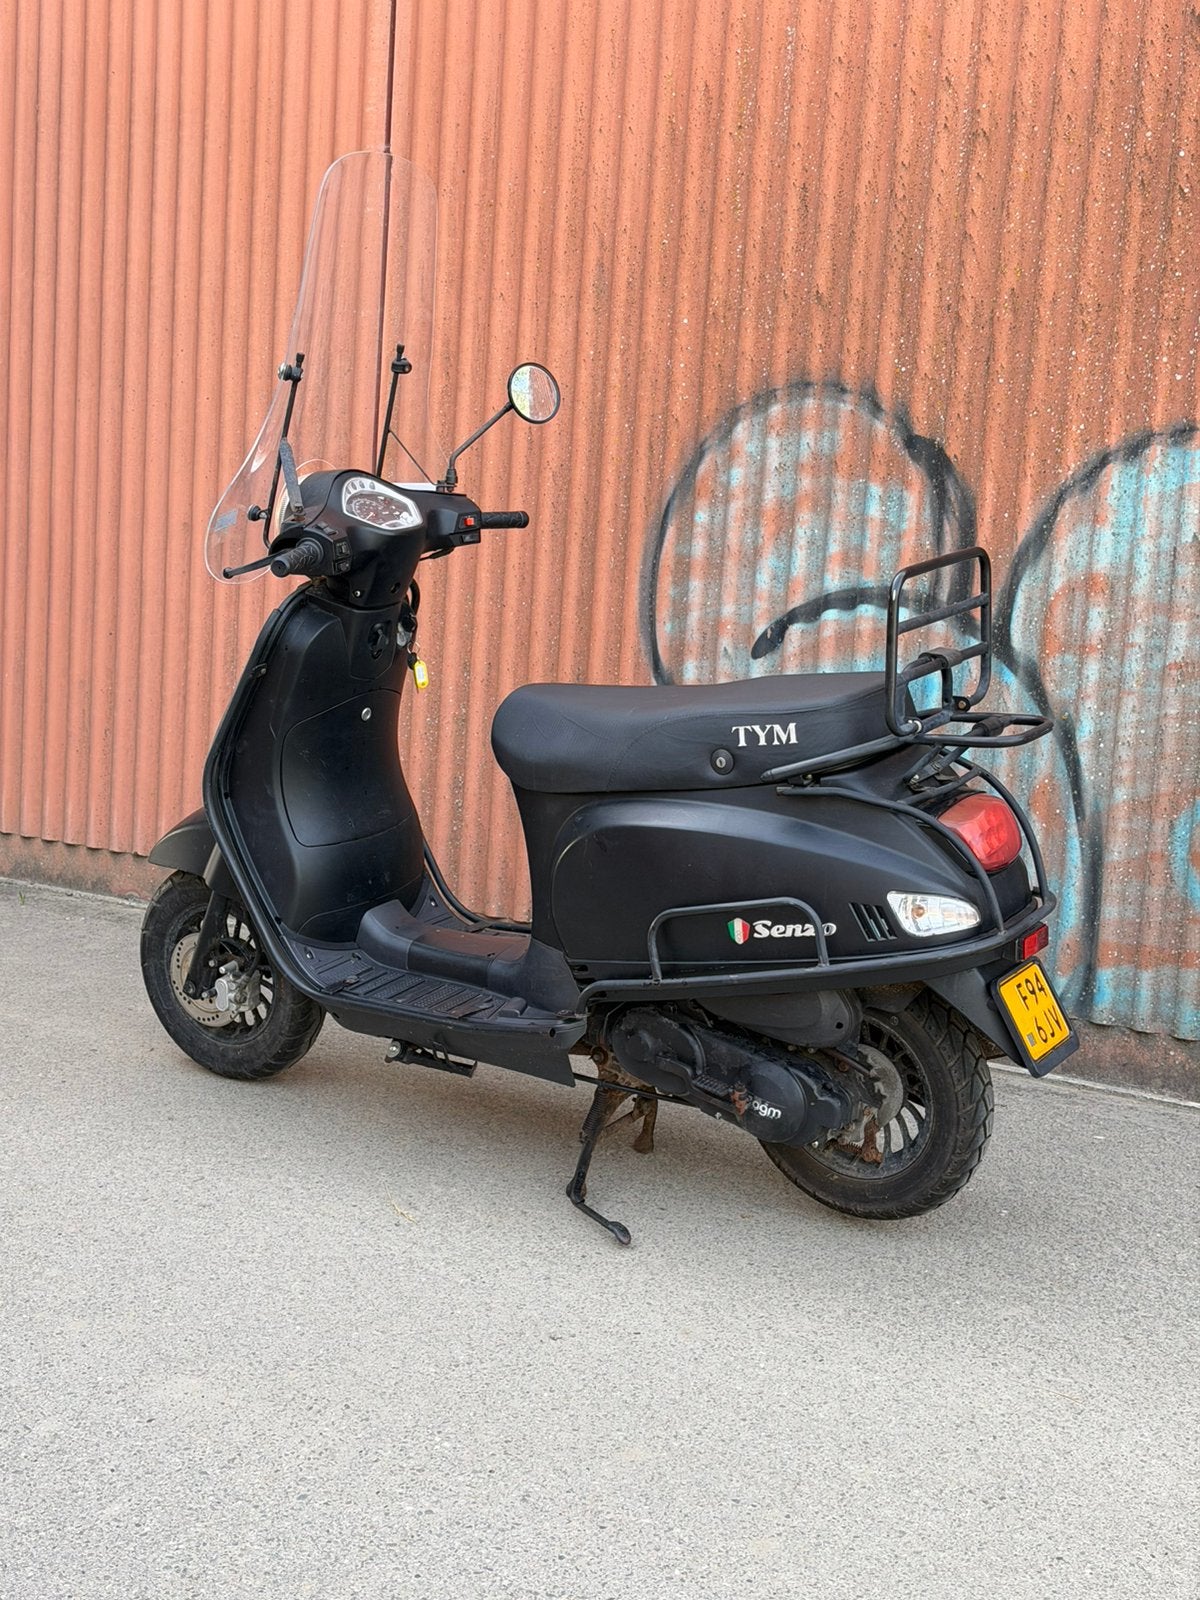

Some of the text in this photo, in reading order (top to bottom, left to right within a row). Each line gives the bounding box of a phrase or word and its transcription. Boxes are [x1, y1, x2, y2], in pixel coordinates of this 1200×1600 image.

[731, 722, 798, 747] TYM
[753, 919, 837, 939] Senzo
[1015, 972, 1048, 1011] F94
[1034, 1005, 1063, 1044] 6JV
[752, 1100, 782, 1119] agm
